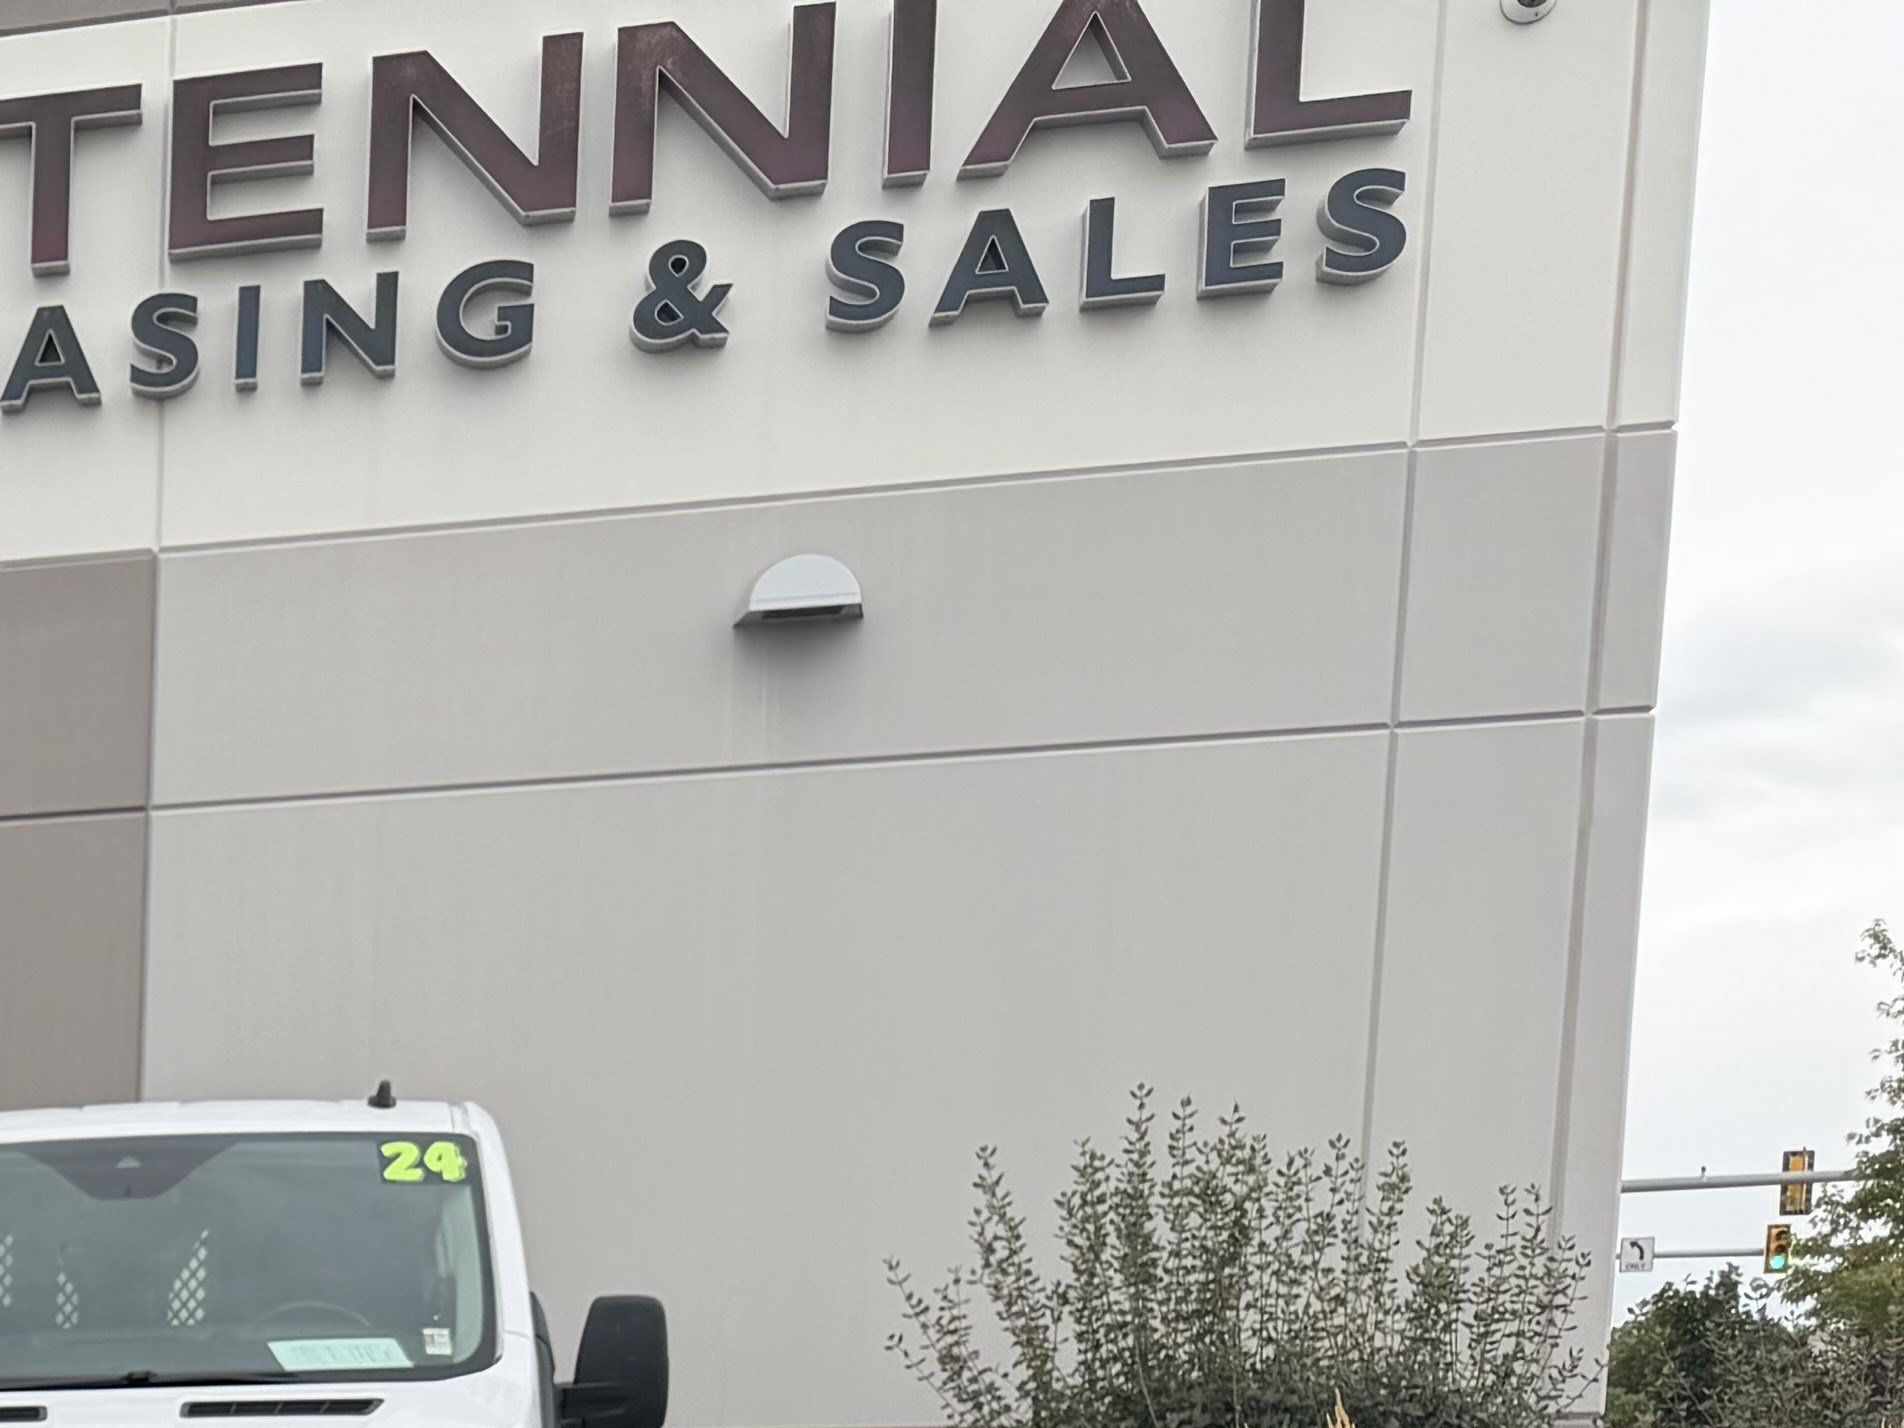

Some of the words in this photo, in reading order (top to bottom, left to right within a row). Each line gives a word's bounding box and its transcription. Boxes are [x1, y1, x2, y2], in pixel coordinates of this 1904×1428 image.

[628, 238, 733, 352] &
[825, 167, 1408, 332] SALES
[380, 1141, 468, 1182] 24
